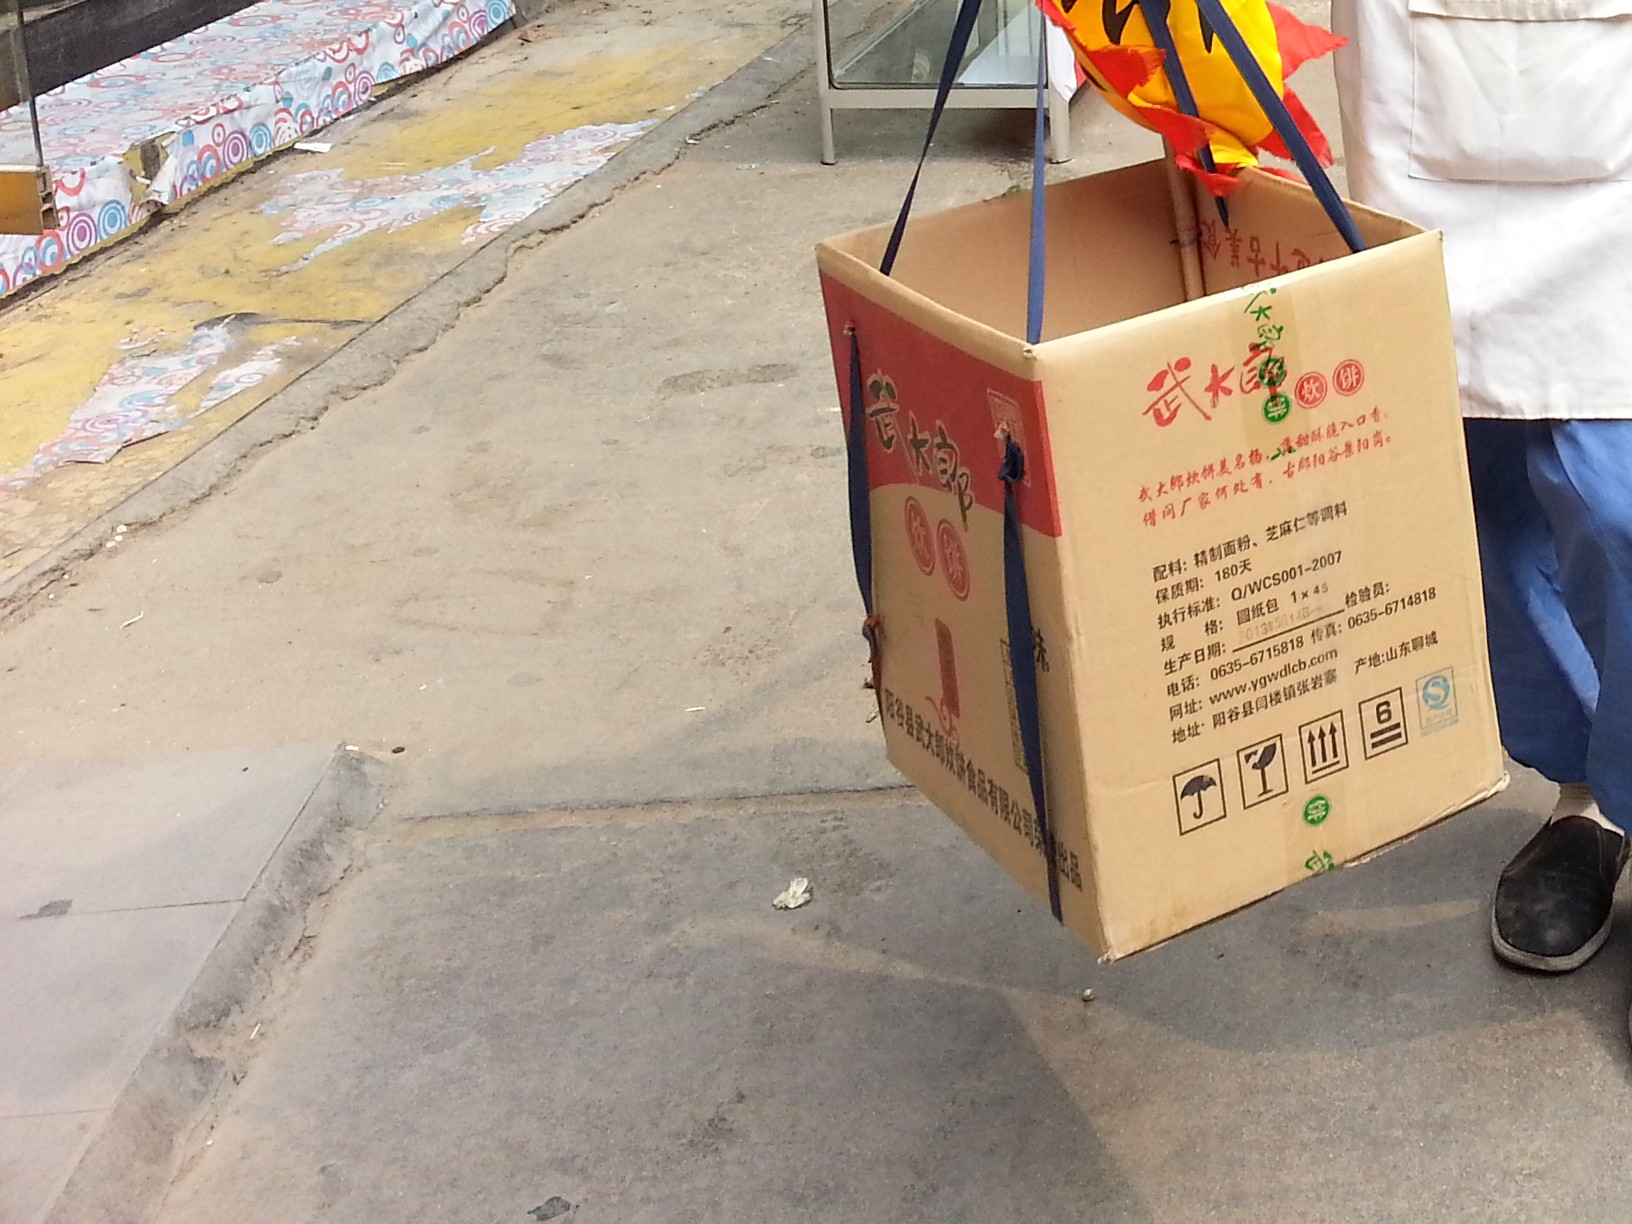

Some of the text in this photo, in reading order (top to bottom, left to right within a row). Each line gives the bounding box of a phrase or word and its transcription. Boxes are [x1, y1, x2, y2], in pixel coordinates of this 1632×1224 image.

[1152, 561, 1187, 582] 配料:
[1155, 559, 1252, 605] 保质期: 180天
[1157, 551, 1342, 629] 执行标准: Q/WCS001-2007
[1163, 642, 1226, 676] 生产日期:
[1345, 582, 1390, 609] 检验员:
[1167, 675, 1200, 697] 电话:
[1210, 635, 1304, 681] 0635-6715818
[1348, 587, 1437, 630] 0635-6714818
[1169, 648, 1338, 722] 网址: www.ygwdlcb.com
[1376, 700, 1391, 724] 6
